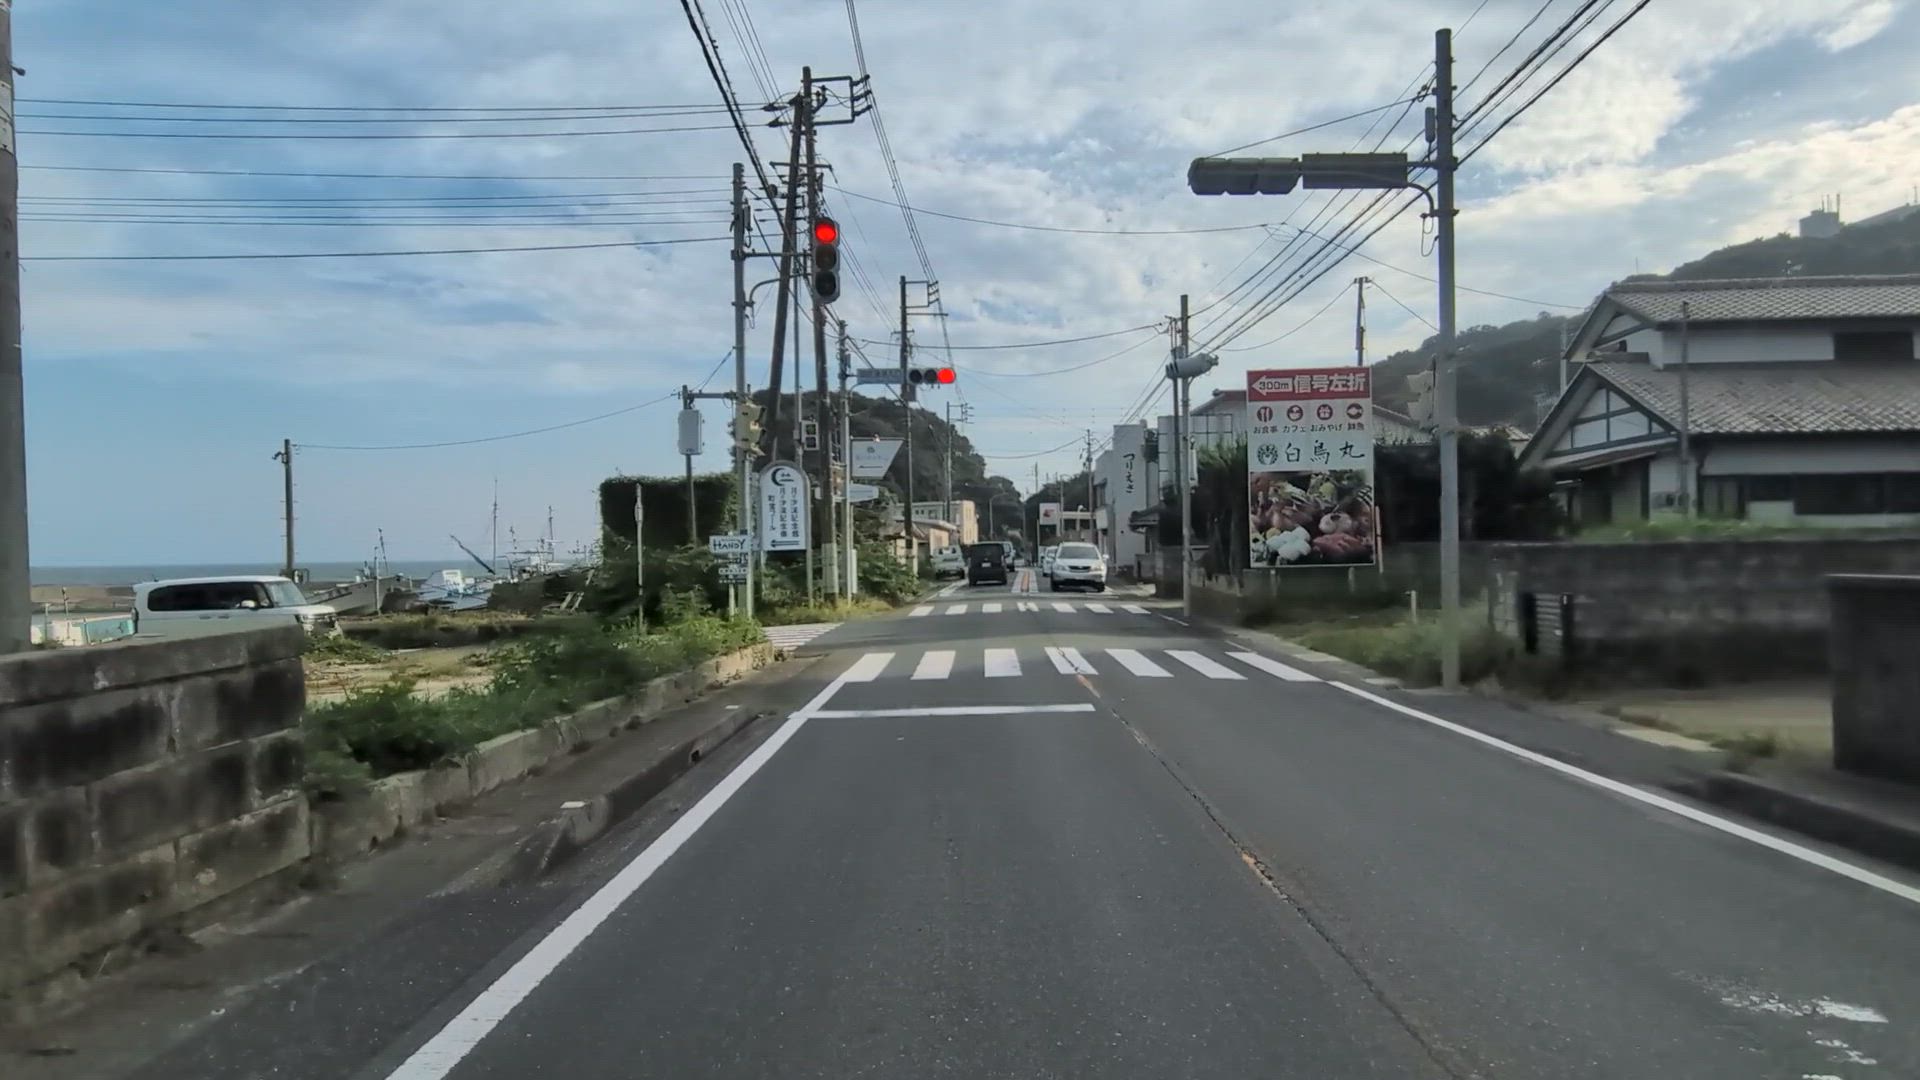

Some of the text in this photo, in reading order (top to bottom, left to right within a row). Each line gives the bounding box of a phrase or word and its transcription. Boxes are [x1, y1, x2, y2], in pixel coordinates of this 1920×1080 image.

[1259, 373, 1366, 393] 300m 信号左折
[1253, 425, 1279, 434] お食事
[1283, 424, 1307, 433] カフェ
[1310, 423, 1343, 432] おみやげ
[1123, 453, 1135, 494] つりえさ
[713, 538, 746, 551] HANDY
